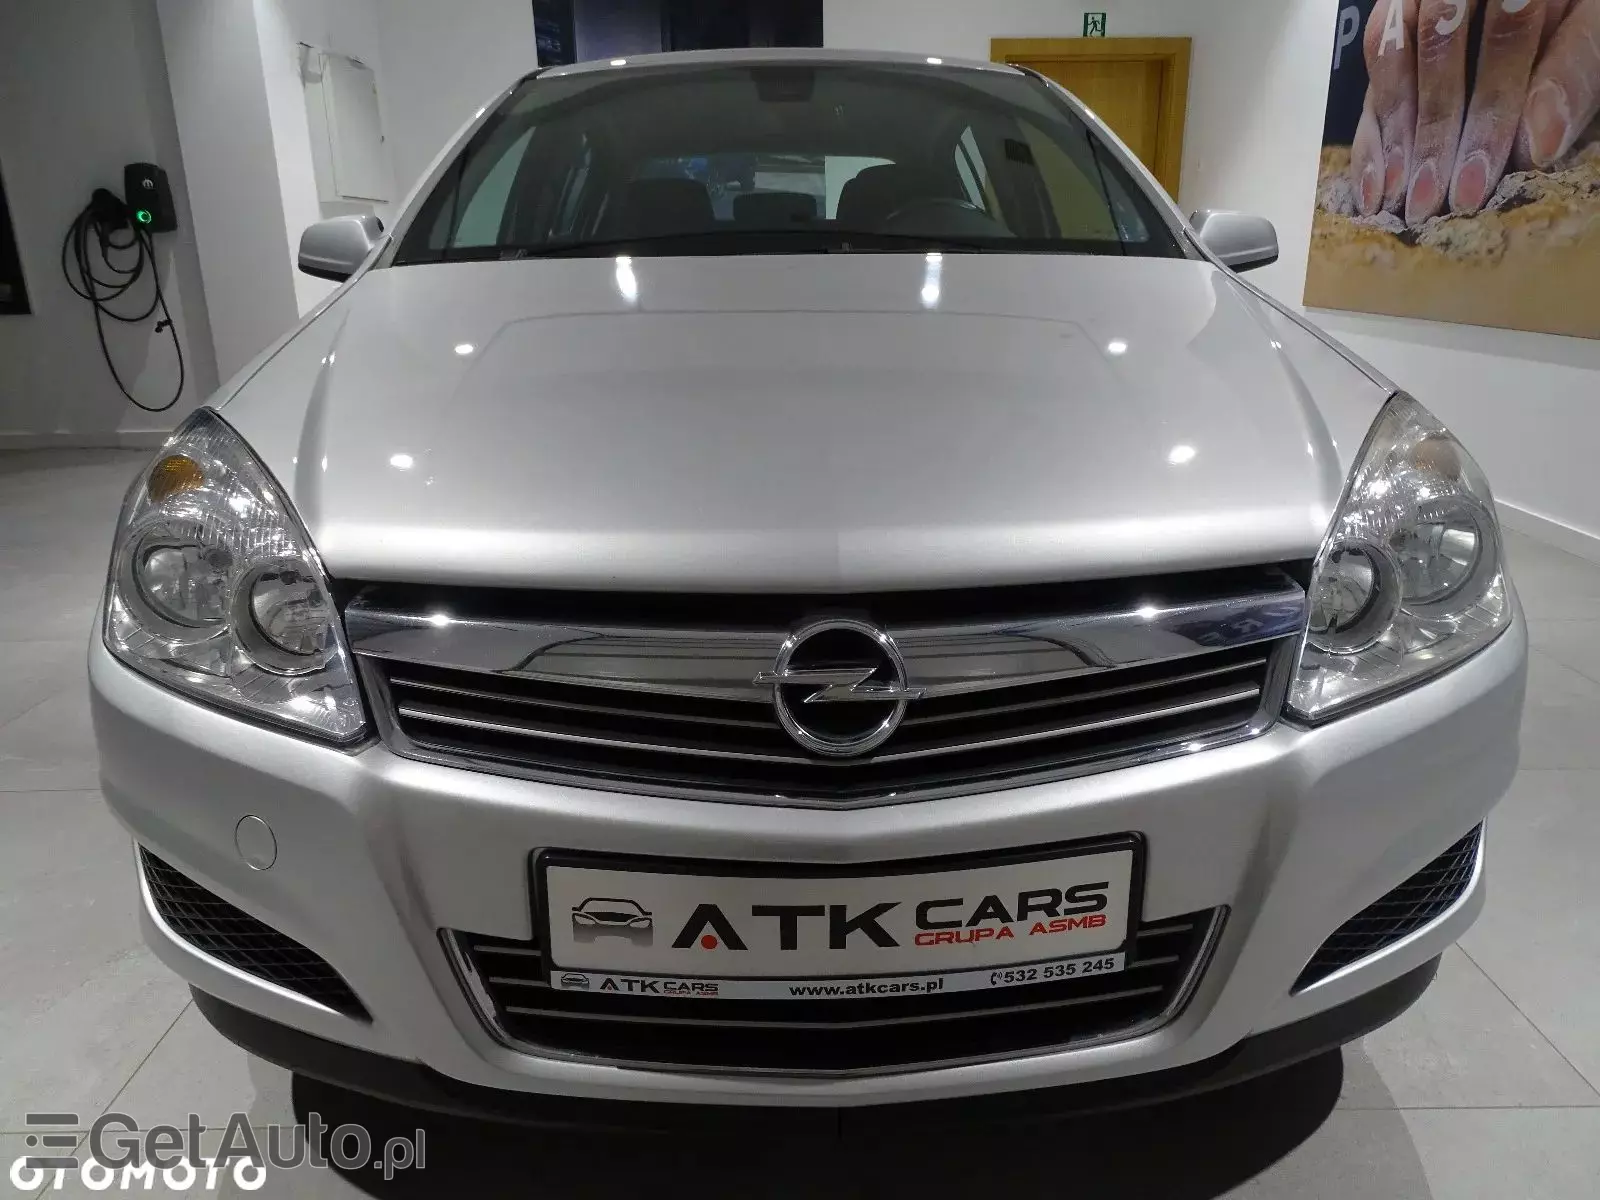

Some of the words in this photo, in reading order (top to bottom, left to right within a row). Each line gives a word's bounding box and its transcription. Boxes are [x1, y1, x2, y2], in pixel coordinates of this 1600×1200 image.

[1333, 0, 1530, 69] PAS
[671, 902, 901, 950] ATK
[915, 882, 1109, 930] CARS
[914, 926, 1015, 947] GRUPA
[1029, 914, 1107, 936] ASMB
[600, 977, 660, 993] ATK
[663, 981, 719, 991] CARS
[1003, 968, 1038, 984] 532
[1043, 962, 1077, 980] 535
[1082, 957, 1116, 974] 245
[788, 977, 944, 997] www.atkcars.pl
